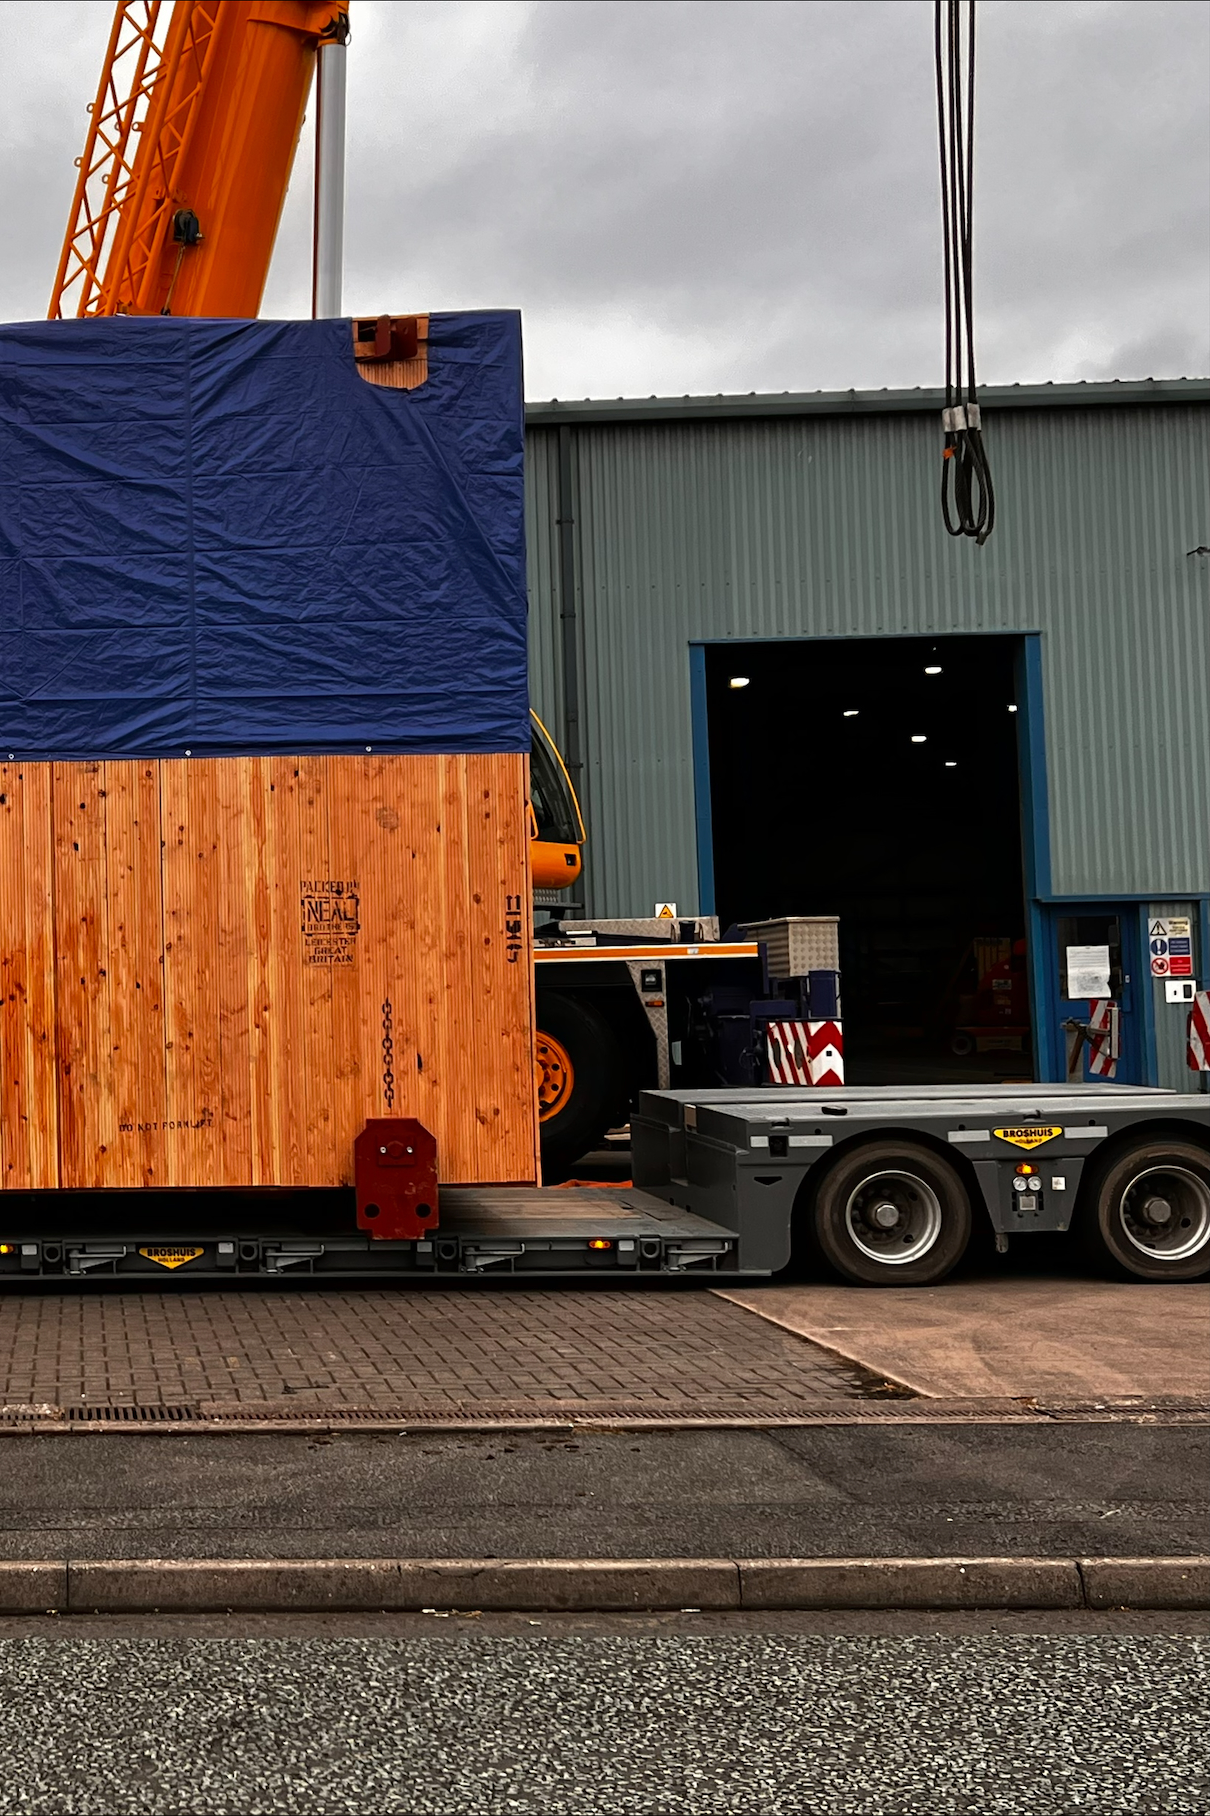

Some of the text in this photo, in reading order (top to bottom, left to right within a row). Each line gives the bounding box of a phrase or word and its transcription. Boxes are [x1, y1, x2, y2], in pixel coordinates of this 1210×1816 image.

[300, 880, 344, 893] PACKED
[307, 900, 355, 923] NEAL
[314, 946, 347, 955] GREAT
[308, 954, 354, 963] BRITAIN
[119, 1118, 212, 1132] DO NOT FORKLIFT
[1003, 1128, 1054, 1138] BROSHUIS
[147, 1247, 196, 1257] BROSHUIS
